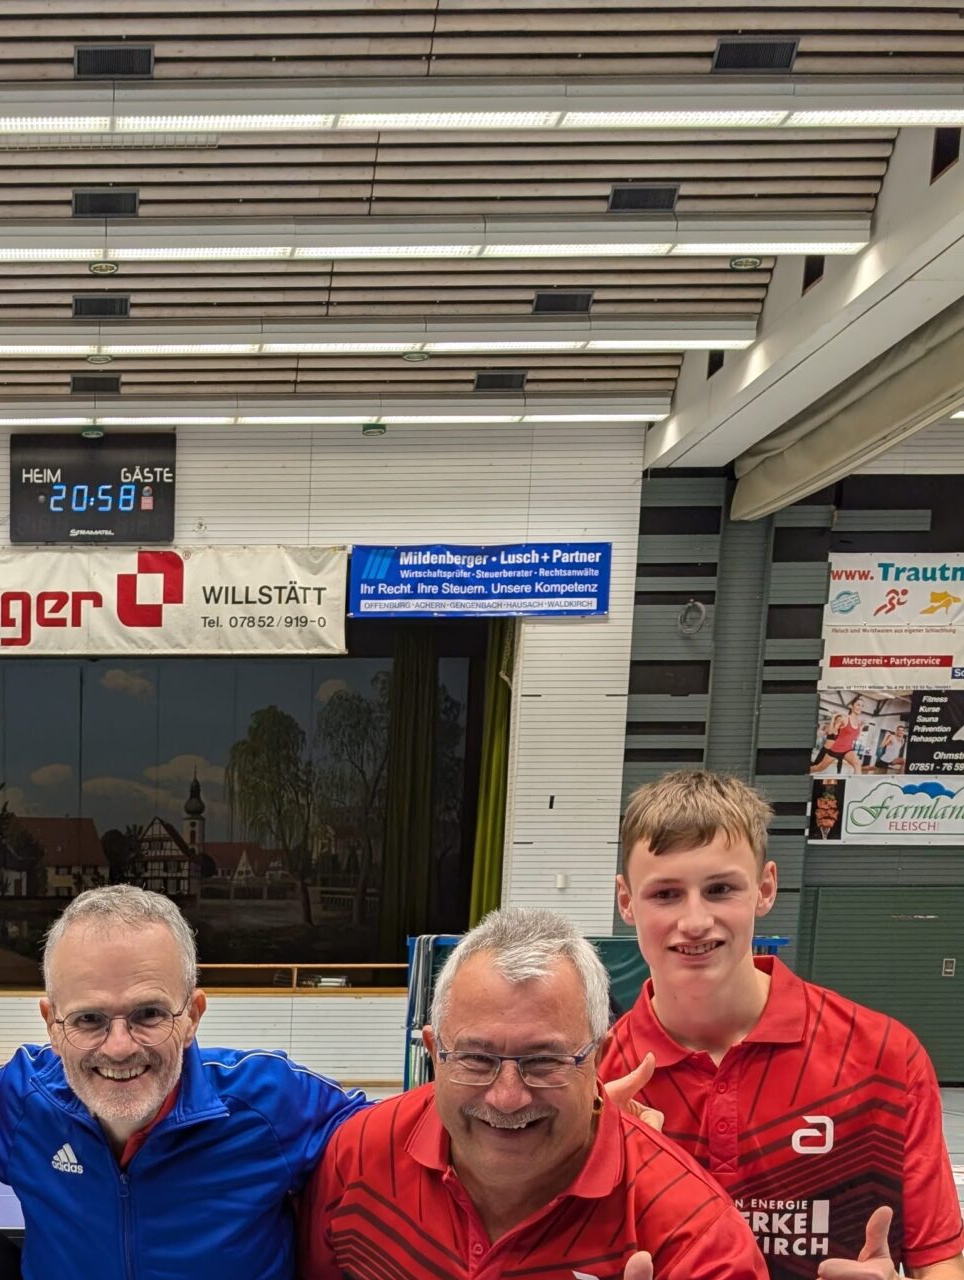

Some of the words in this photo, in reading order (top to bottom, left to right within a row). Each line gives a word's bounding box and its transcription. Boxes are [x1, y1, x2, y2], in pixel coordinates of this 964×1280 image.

[22, 468, 61, 483] HEIM
[121, 466, 173, 483] GÄSTE
[50, 484, 136, 512] 20:58
[69, 529, 115, 537] STRAMATEL
[399, 550, 488, 568] Mildenberger
[500, 550, 539, 565] Lusch
[552, 550, 602, 564] Partner
[202, 581, 327, 606] WILLSTÄTT
[360, 583, 376, 594] Ihr
[378, 583, 414, 595] Recht.
[417, 583, 439, 594] Ihre
[441, 583, 488, 594] Steuern.
[491, 583, 532, 594] Unsere
[535, 582, 598, 596] Kompetenz
[449, 601, 503, 609] GENGENBACH
[547, 600, 593, 608] WALDKIRCH
[201, 616, 224, 629] Tel.
[841, 656, 883, 666] Metzgerei
[889, 657, 941, 667] Partyservice
[922, 695, 948, 703] Fitness
[916, 715, 939, 723] Sauna
[913, 725, 951, 733] Prävention
[910, 735, 947, 743] Rehasport
[909, 763, 934, 771] 07851
[888, 821, 936, 831] FLEISCH
[51, 1160, 84, 1174] adidas
[751, 1199, 808, 1210] ENERGIE
[757, 1237, 829, 1256] IRCH
